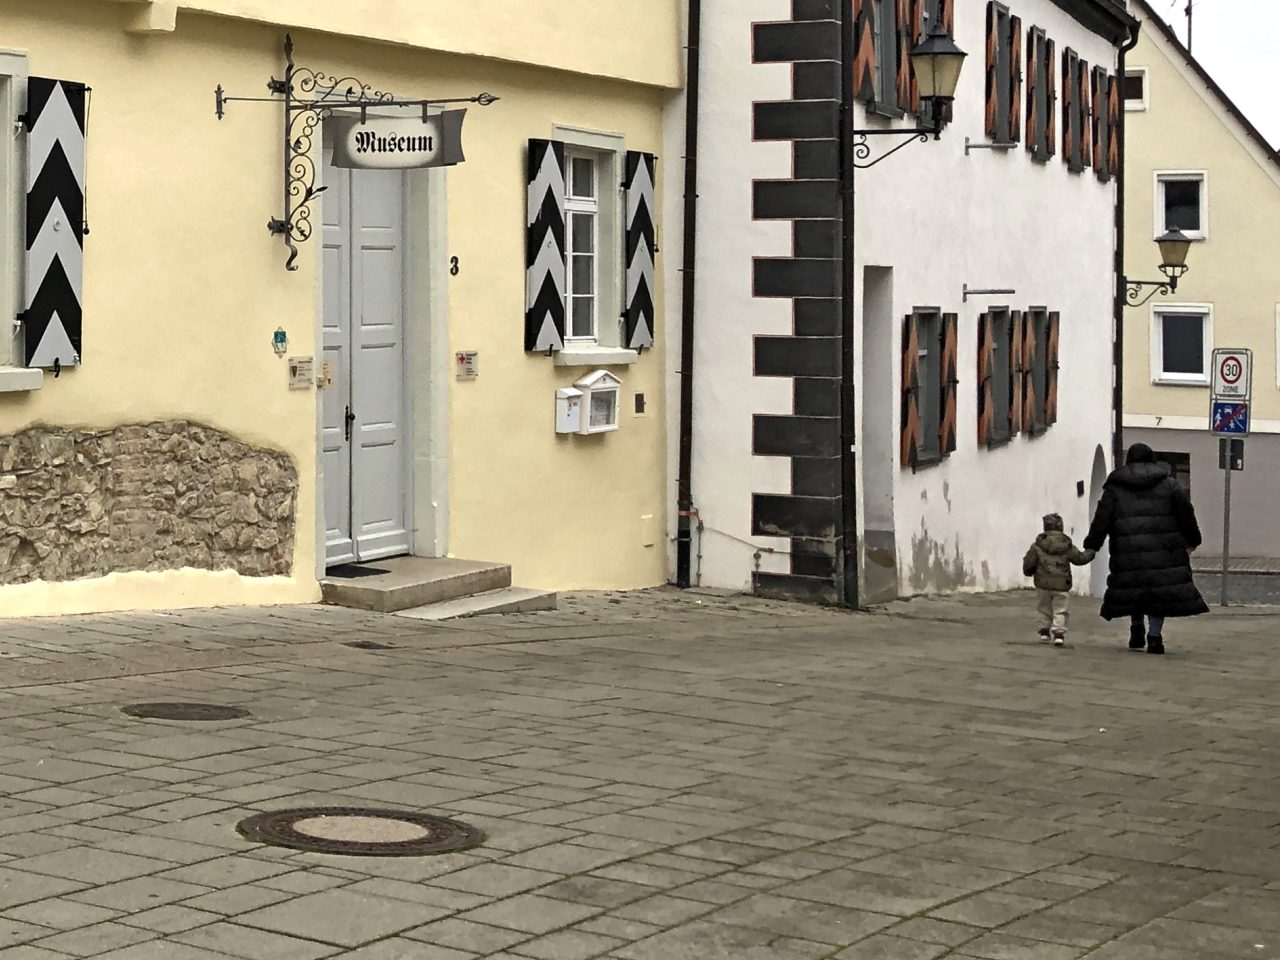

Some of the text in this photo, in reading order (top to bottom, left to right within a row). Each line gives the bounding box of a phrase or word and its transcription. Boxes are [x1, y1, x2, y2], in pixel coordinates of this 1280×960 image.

[355, 131, 433, 153] Museum
[450, 255, 459, 276] 3
[1225, 363, 1238, 377] 30
[1222, 385, 1239, 394] ZONE
[1155, 416, 1162, 426] 7
